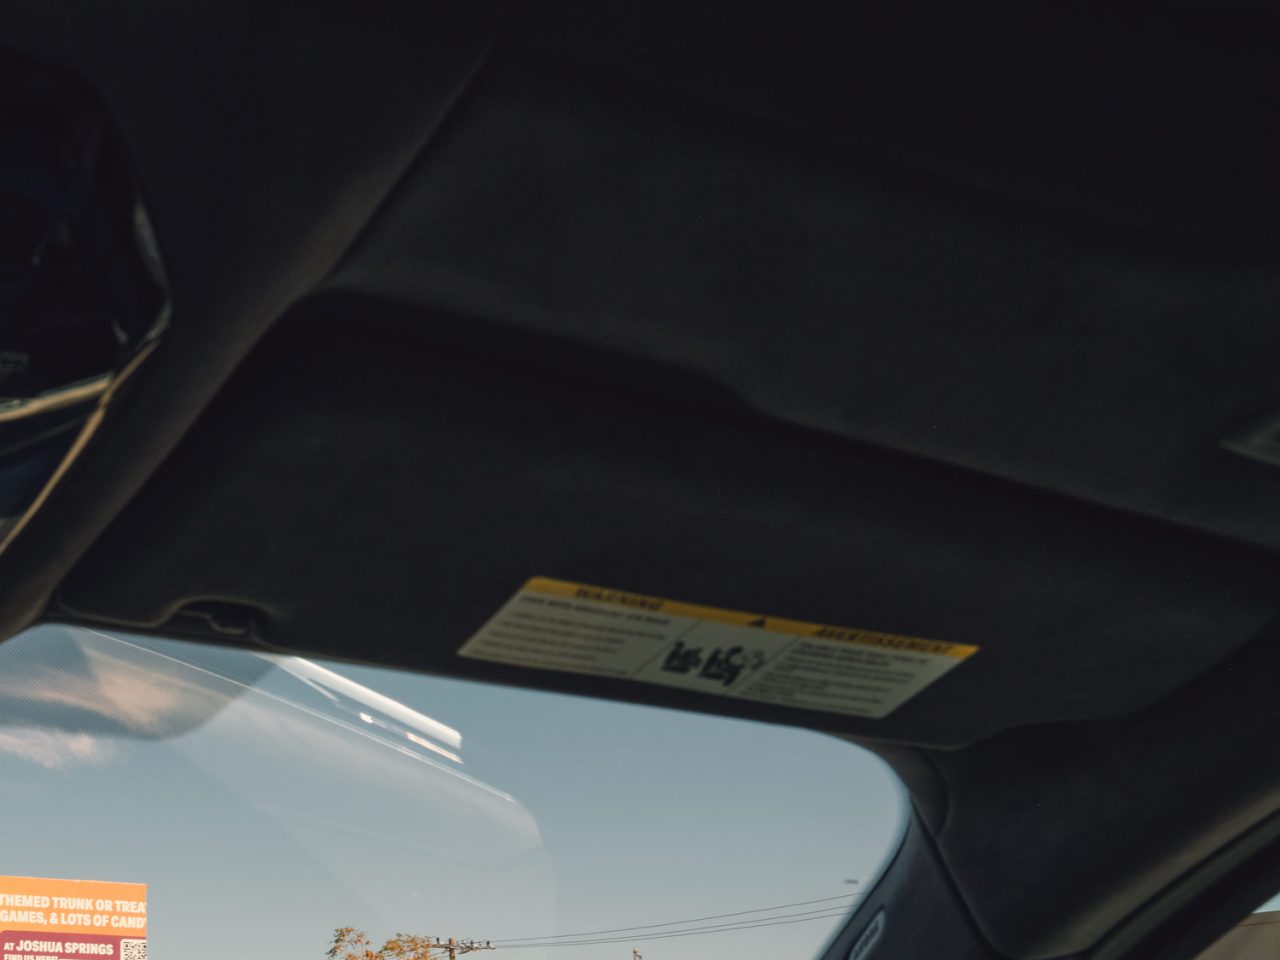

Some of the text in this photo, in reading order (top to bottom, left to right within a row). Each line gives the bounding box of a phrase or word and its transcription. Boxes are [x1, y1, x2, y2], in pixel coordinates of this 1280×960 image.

[52, 897, 94, 911] TRUNK
[95, 899, 113, 911] OR
[115, 900, 147, 914] TREA
[0, 910, 147, 929] GAMES, & LOTS OF CAND
[4, 940, 114, 955] AT JOSHUA SPRINGS
